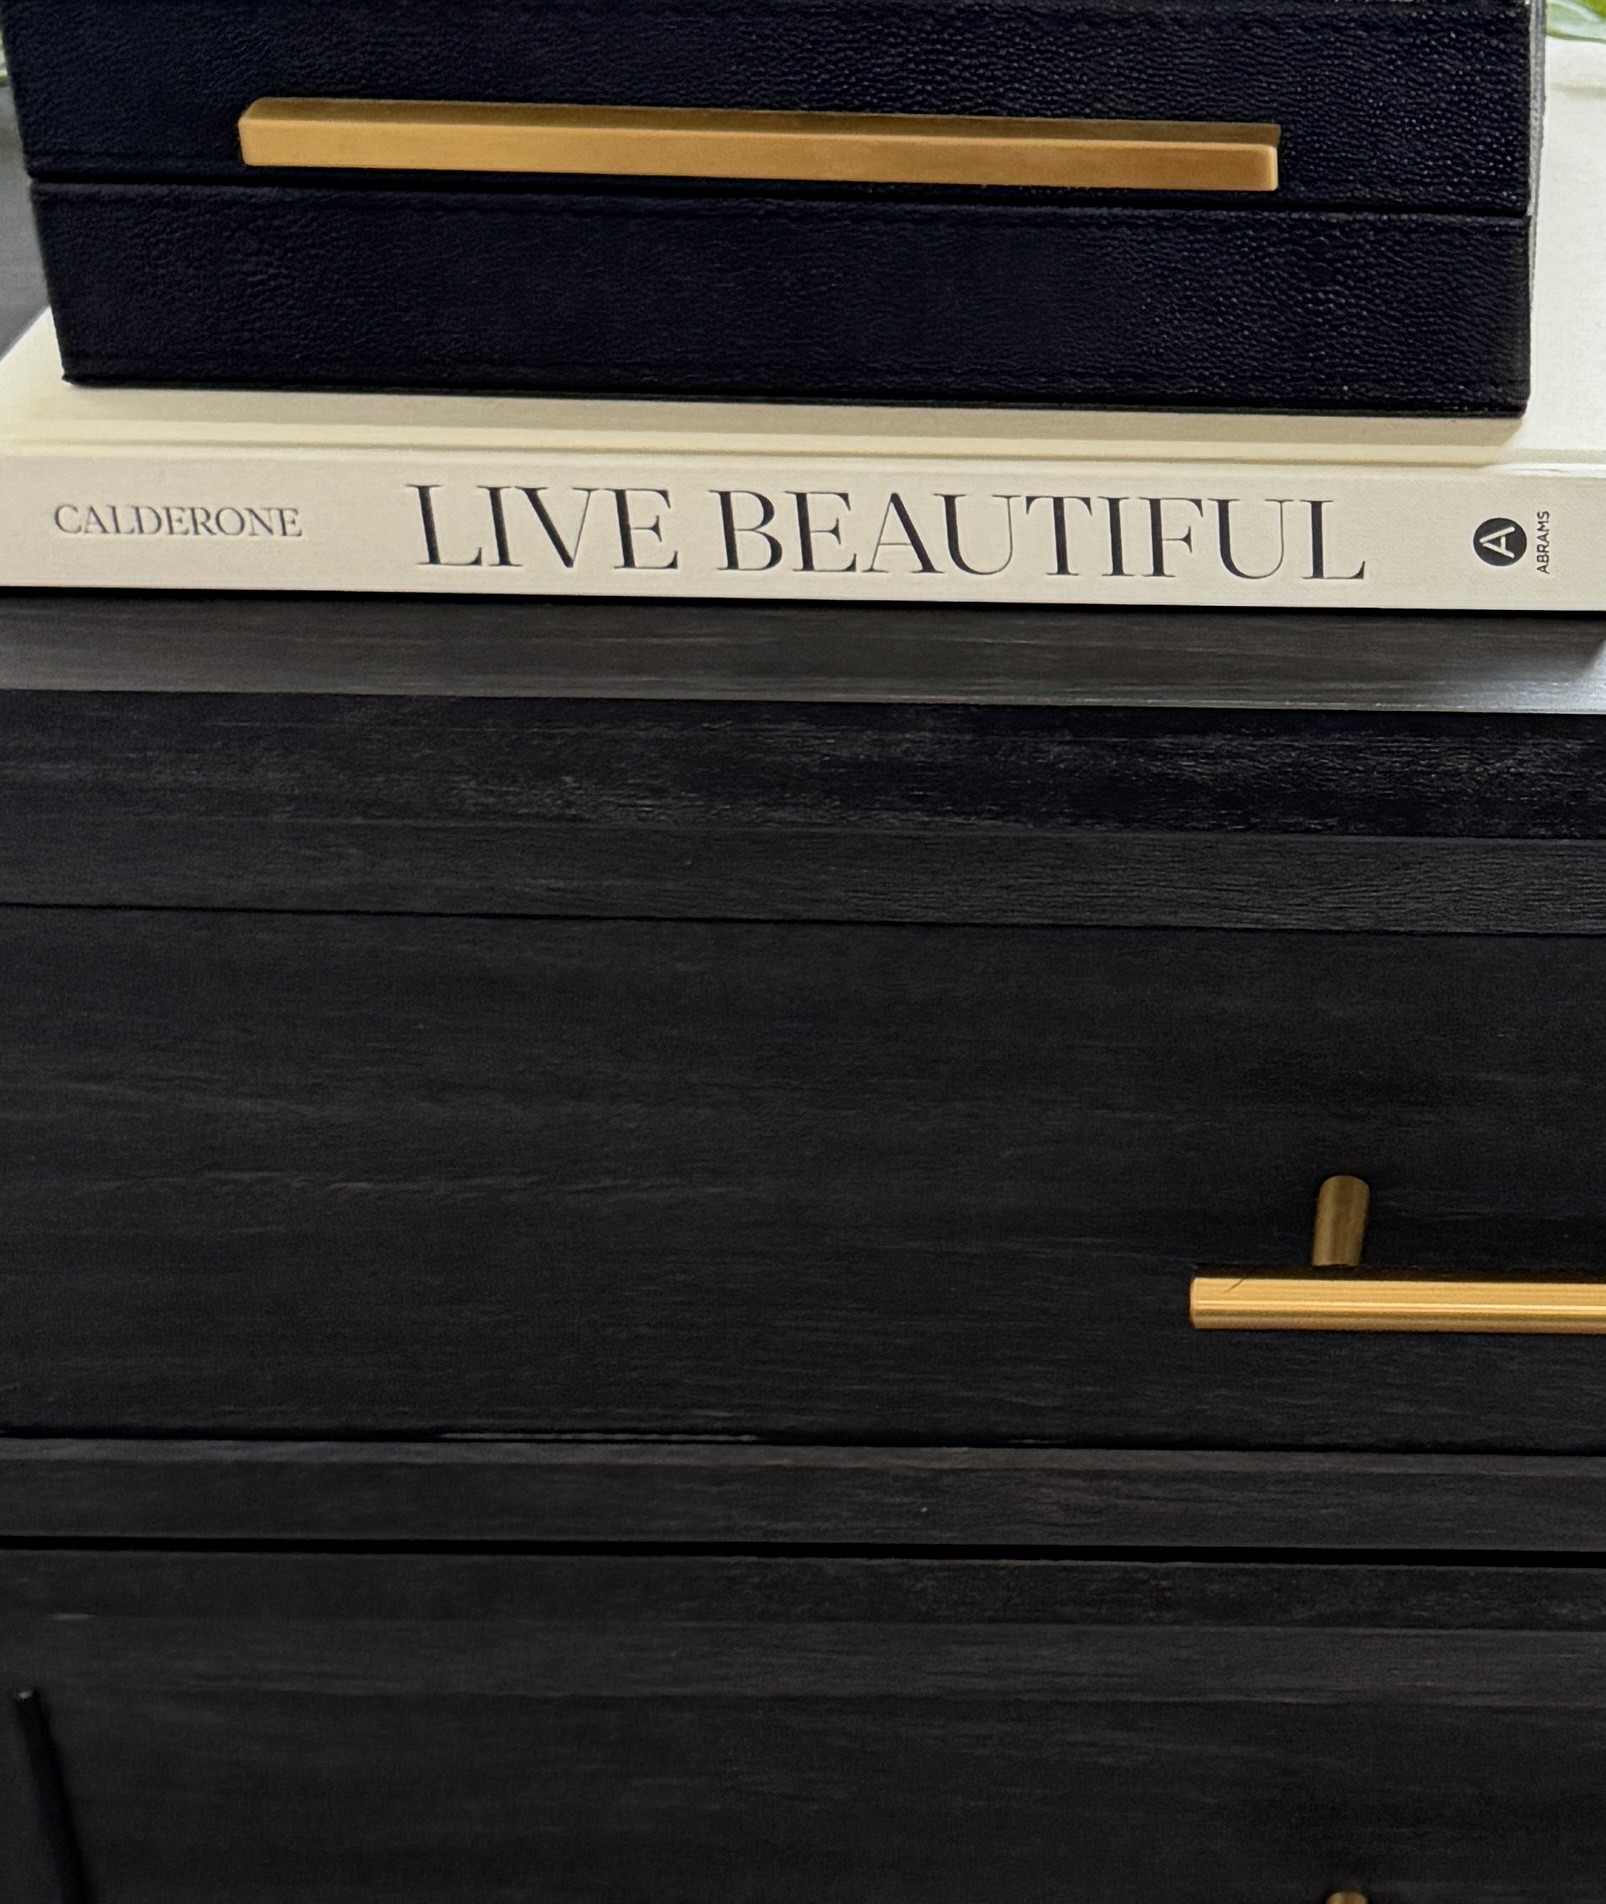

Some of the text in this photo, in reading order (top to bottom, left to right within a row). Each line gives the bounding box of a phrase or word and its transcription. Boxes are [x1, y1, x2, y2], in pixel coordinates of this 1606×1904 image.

[53, 503, 303, 539] CALDERONE
[407, 483, 1367, 581] LIVE BEAUTIFUL
[1536, 510, 1550, 575] ABRAMS
